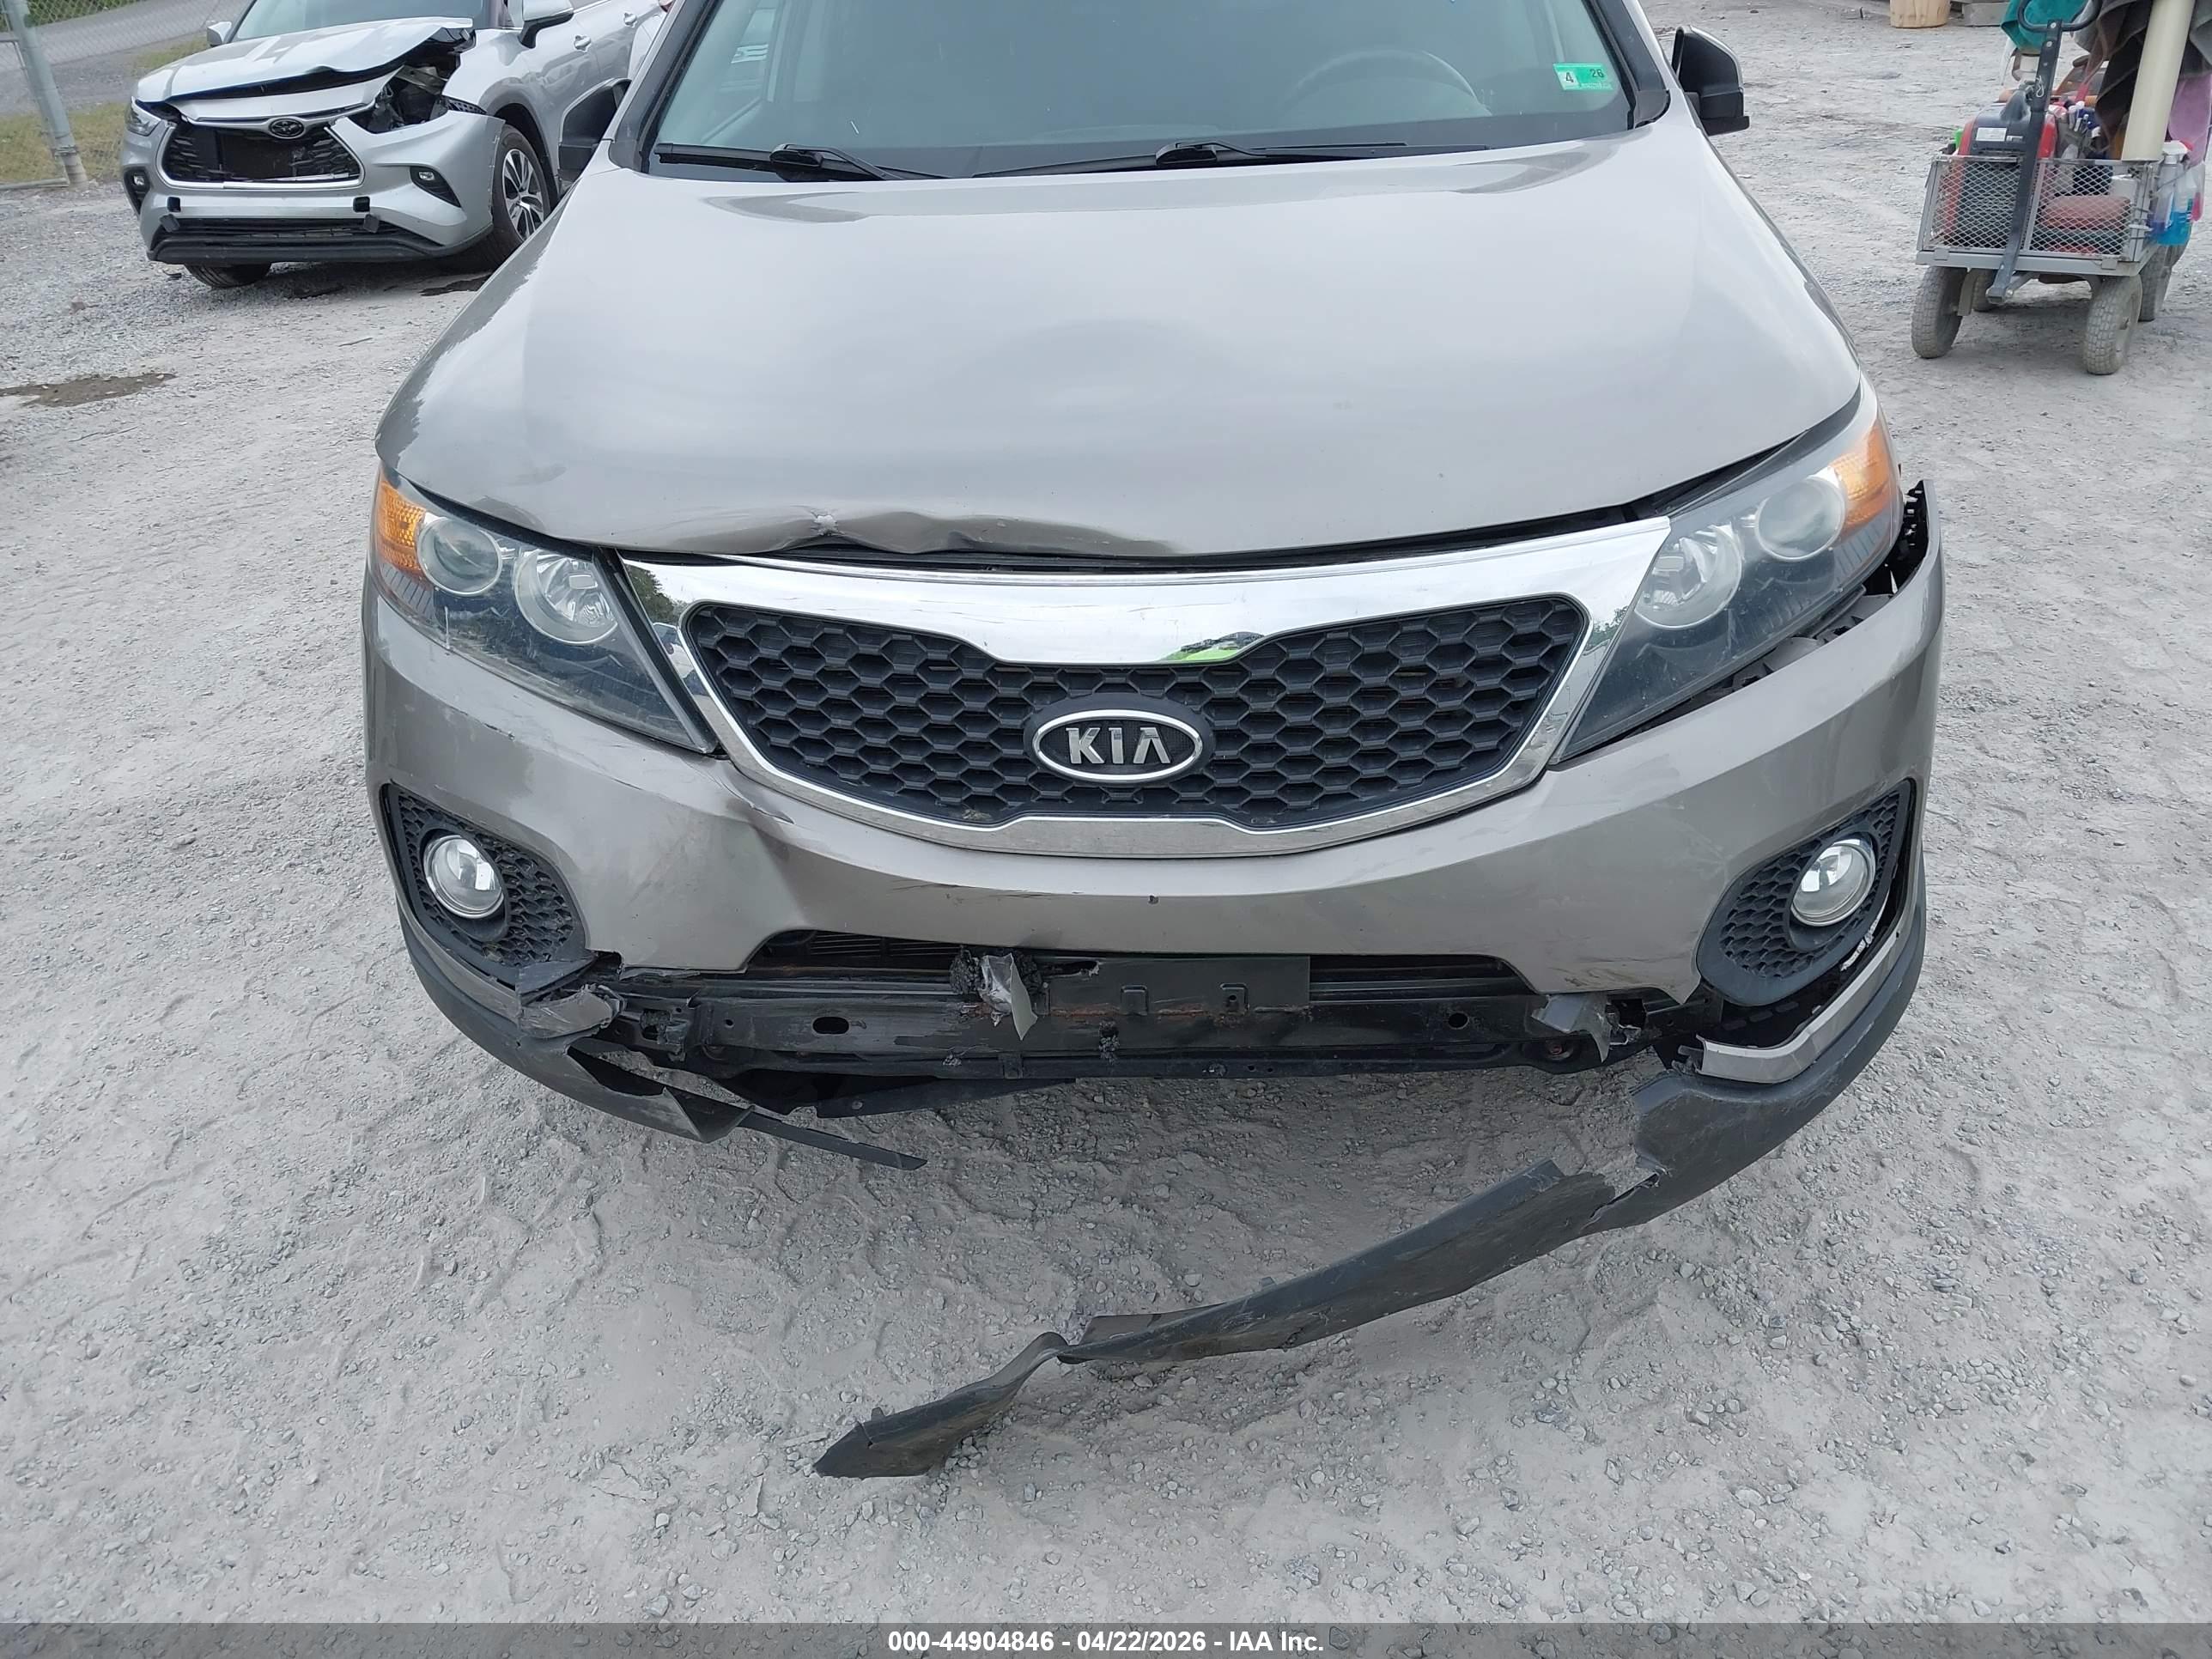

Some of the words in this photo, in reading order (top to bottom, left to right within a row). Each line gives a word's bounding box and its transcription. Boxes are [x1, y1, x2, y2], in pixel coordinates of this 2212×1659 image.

[1565, 72, 1574, 83] 4
[1589, 69, 1605, 78] 26
[1065, 726, 1171, 764] KIA
